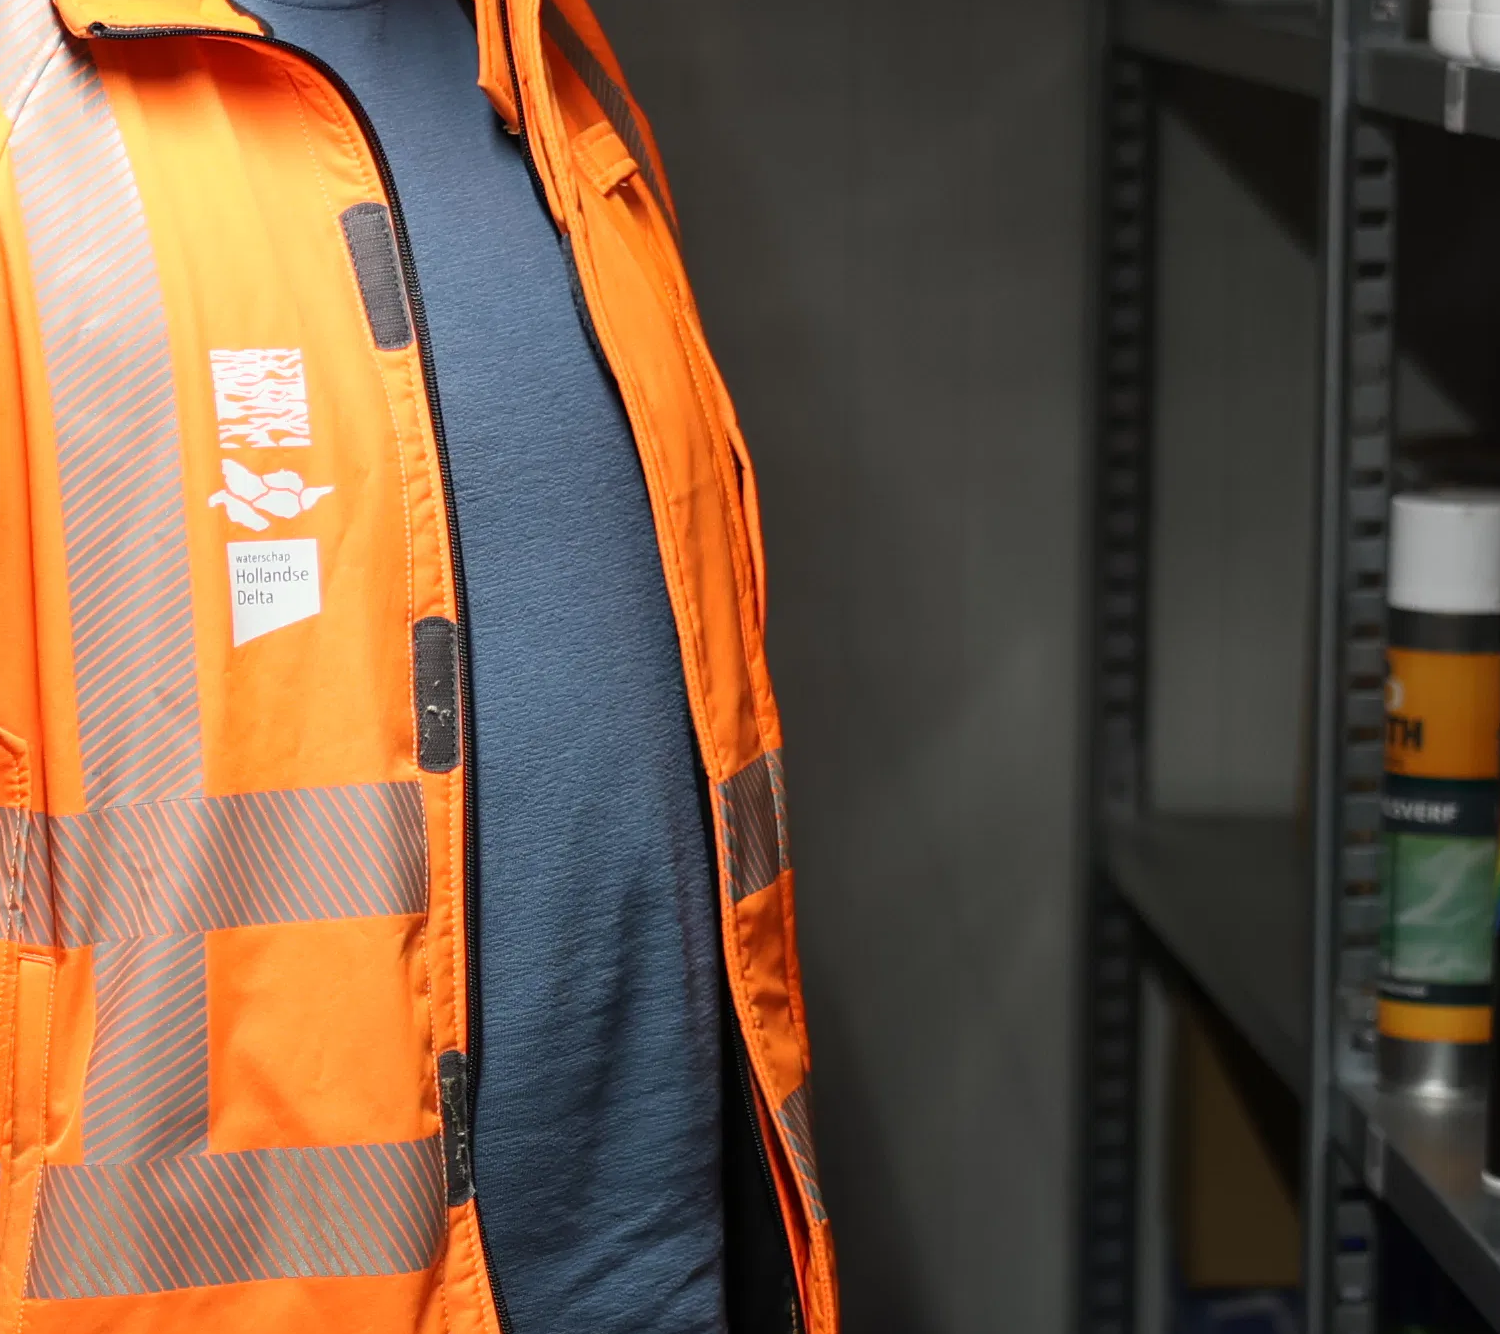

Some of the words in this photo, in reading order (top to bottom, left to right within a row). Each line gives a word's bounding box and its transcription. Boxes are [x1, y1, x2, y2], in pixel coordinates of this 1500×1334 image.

[235, 551, 291, 564] waterschap
[236, 567, 310, 585] Hollandse
[237, 589, 275, 606] Delta
